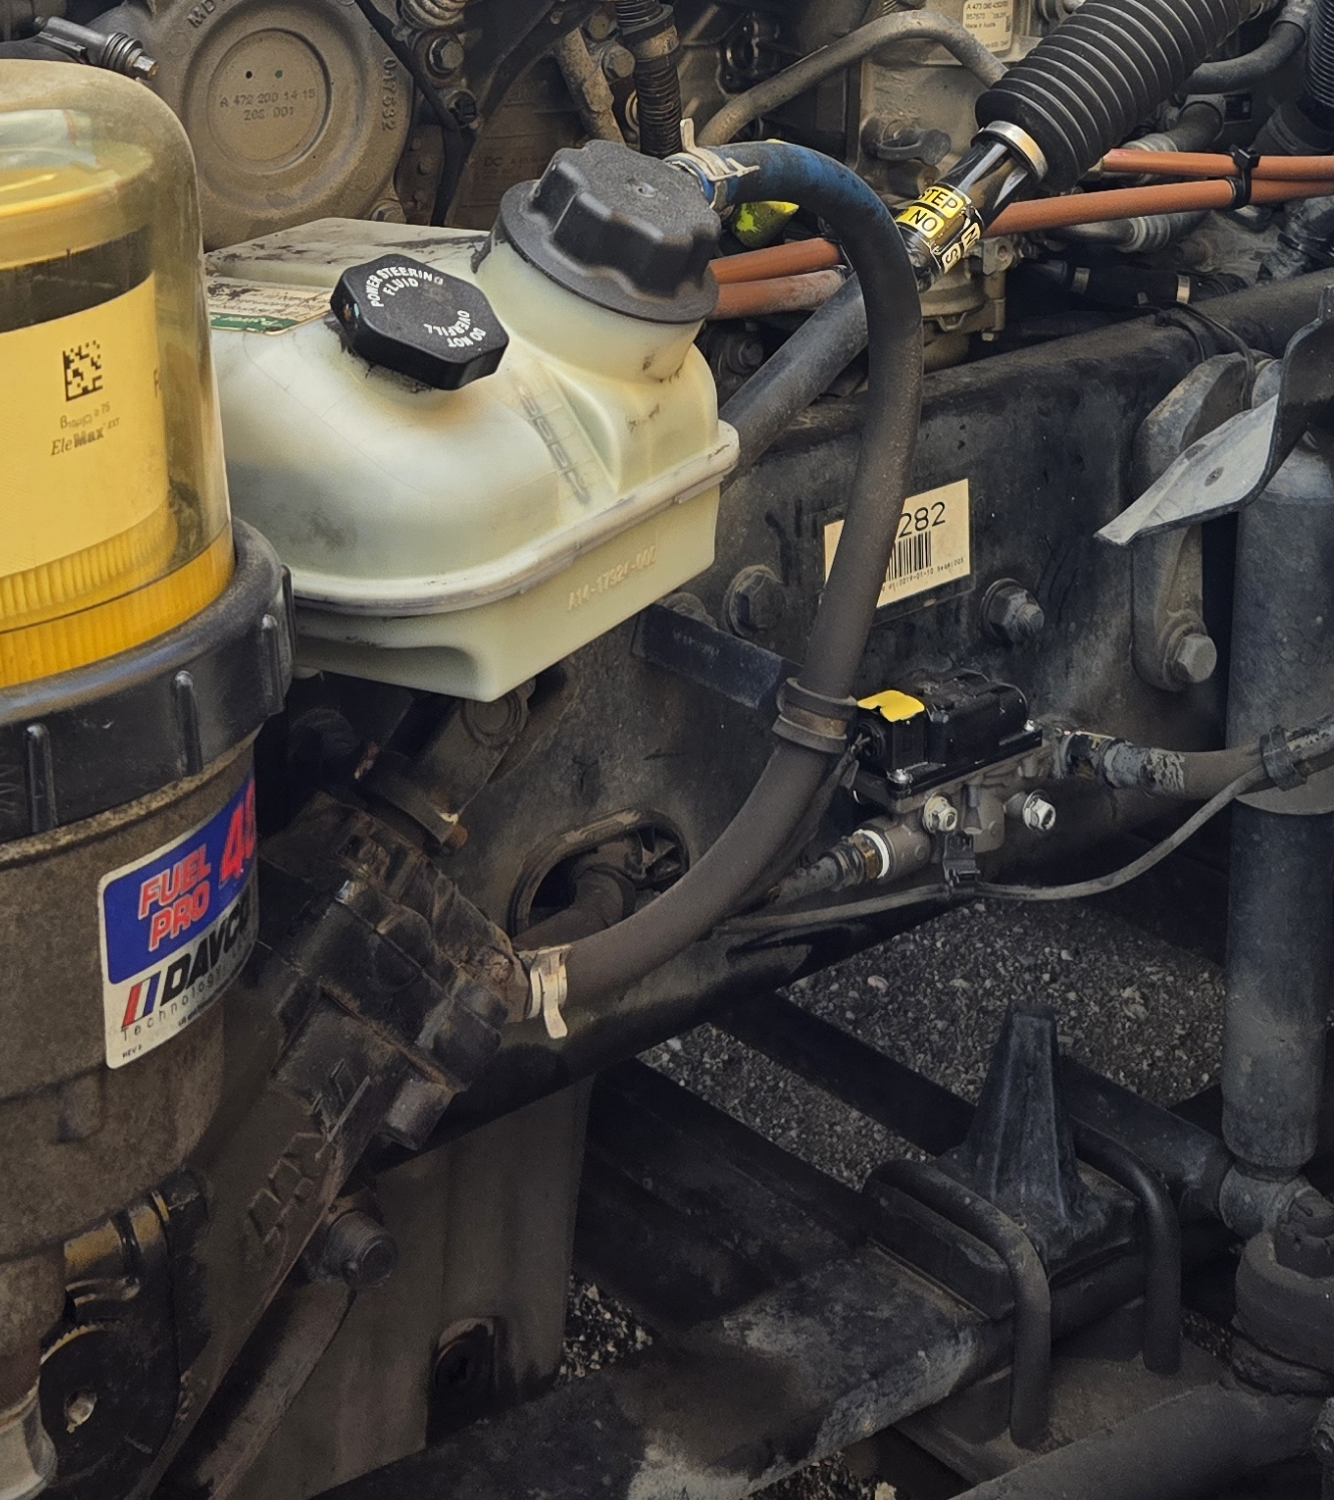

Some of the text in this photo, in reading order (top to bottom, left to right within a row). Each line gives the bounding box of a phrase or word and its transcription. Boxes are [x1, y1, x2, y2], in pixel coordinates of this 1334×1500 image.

[219, 95, 229, 108] A
[922, 188, 958, 209] TEP
[908, 209, 938, 232] NO
[366, 266, 444, 307] POWER STEERING
[382, 277, 419, 296] FLUID
[423, 310, 471, 337] OVERFILL
[447, 327, 487, 348] DO NOT
[51, 427, 104, 456] EleMax
[898, 501, 946, 539] 282
[138, 844, 211, 920] FUEL
[149, 880, 210, 953] PRO
